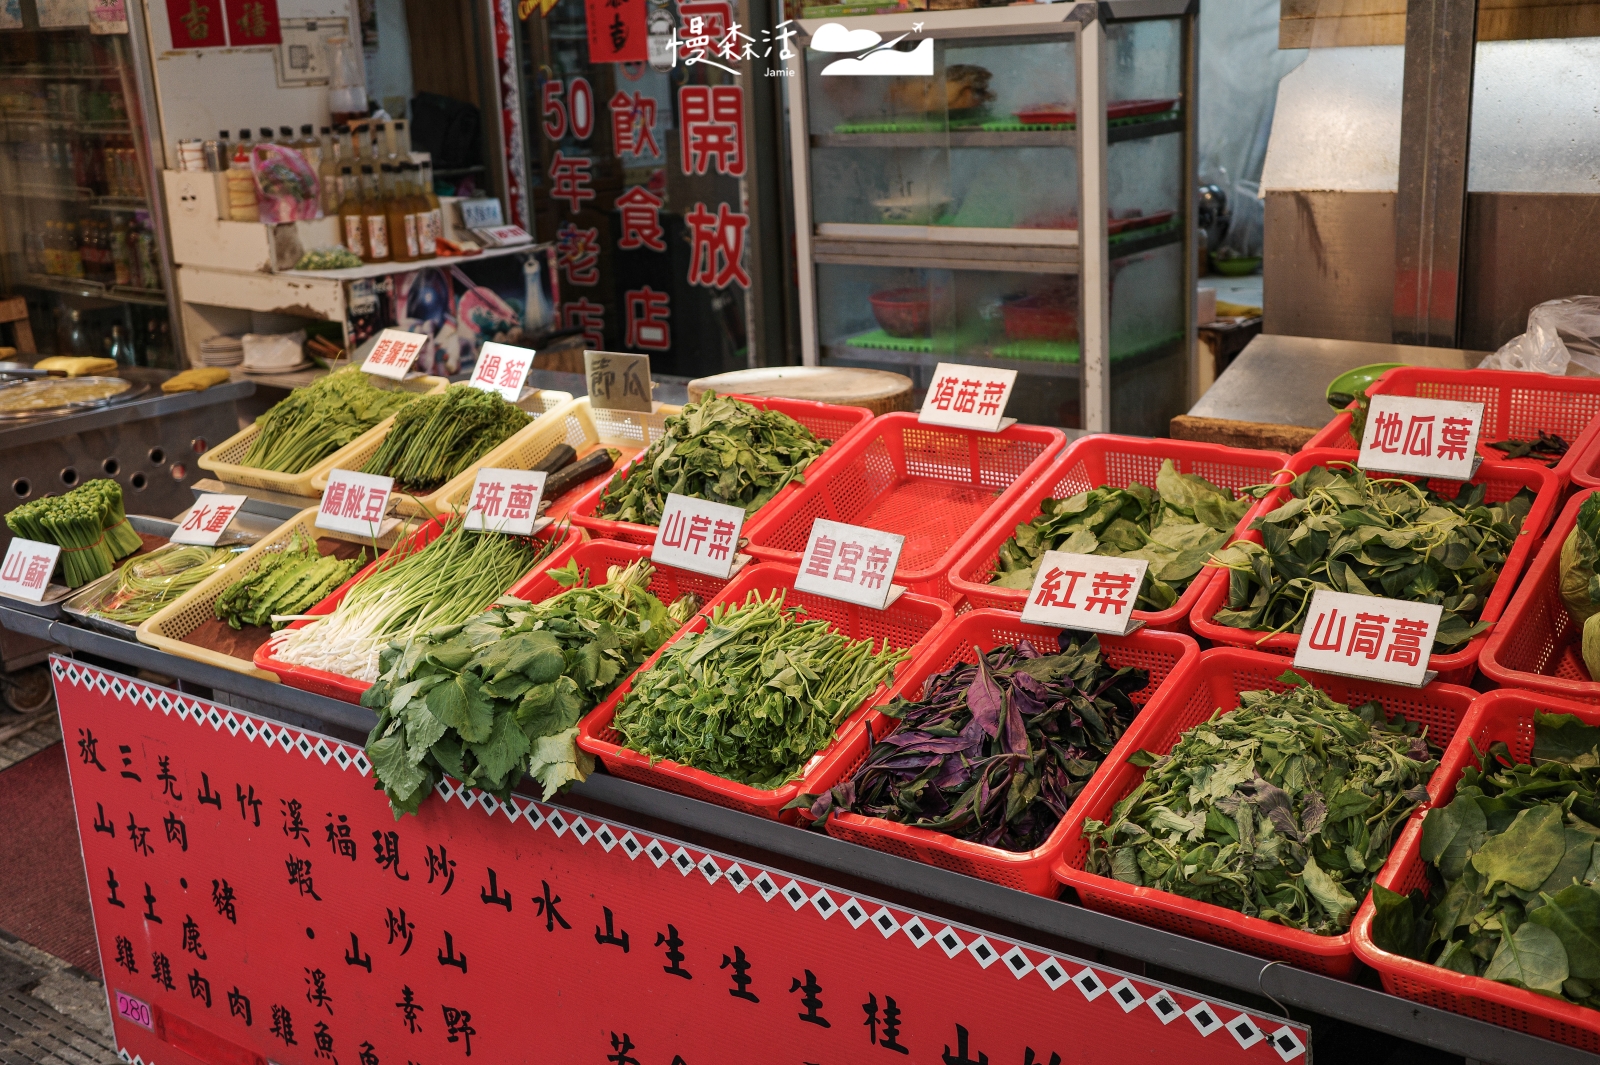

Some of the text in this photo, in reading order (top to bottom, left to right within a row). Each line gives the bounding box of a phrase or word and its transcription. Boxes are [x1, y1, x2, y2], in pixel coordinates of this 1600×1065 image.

[608, 89, 671, 350] 飲食店
[475, 353, 526, 389] 過貓
[931, 376, 1007, 416] 塔菇菜
[1369, 411, 1472, 461] 地瓜葉
[182, 504, 236, 533] 水蓮
[321, 481, 389, 523] 楊桃豆
[661, 509, 736, 561] 山芹菜
[1, 551, 51, 590] 山蘇
[805, 534, 893, 590] 皇宮菜
[1034, 566, 1138, 616] 紅菜
[1308, 608, 1430, 667] 山茼蒿
[118, 995, 151, 1027] 280
